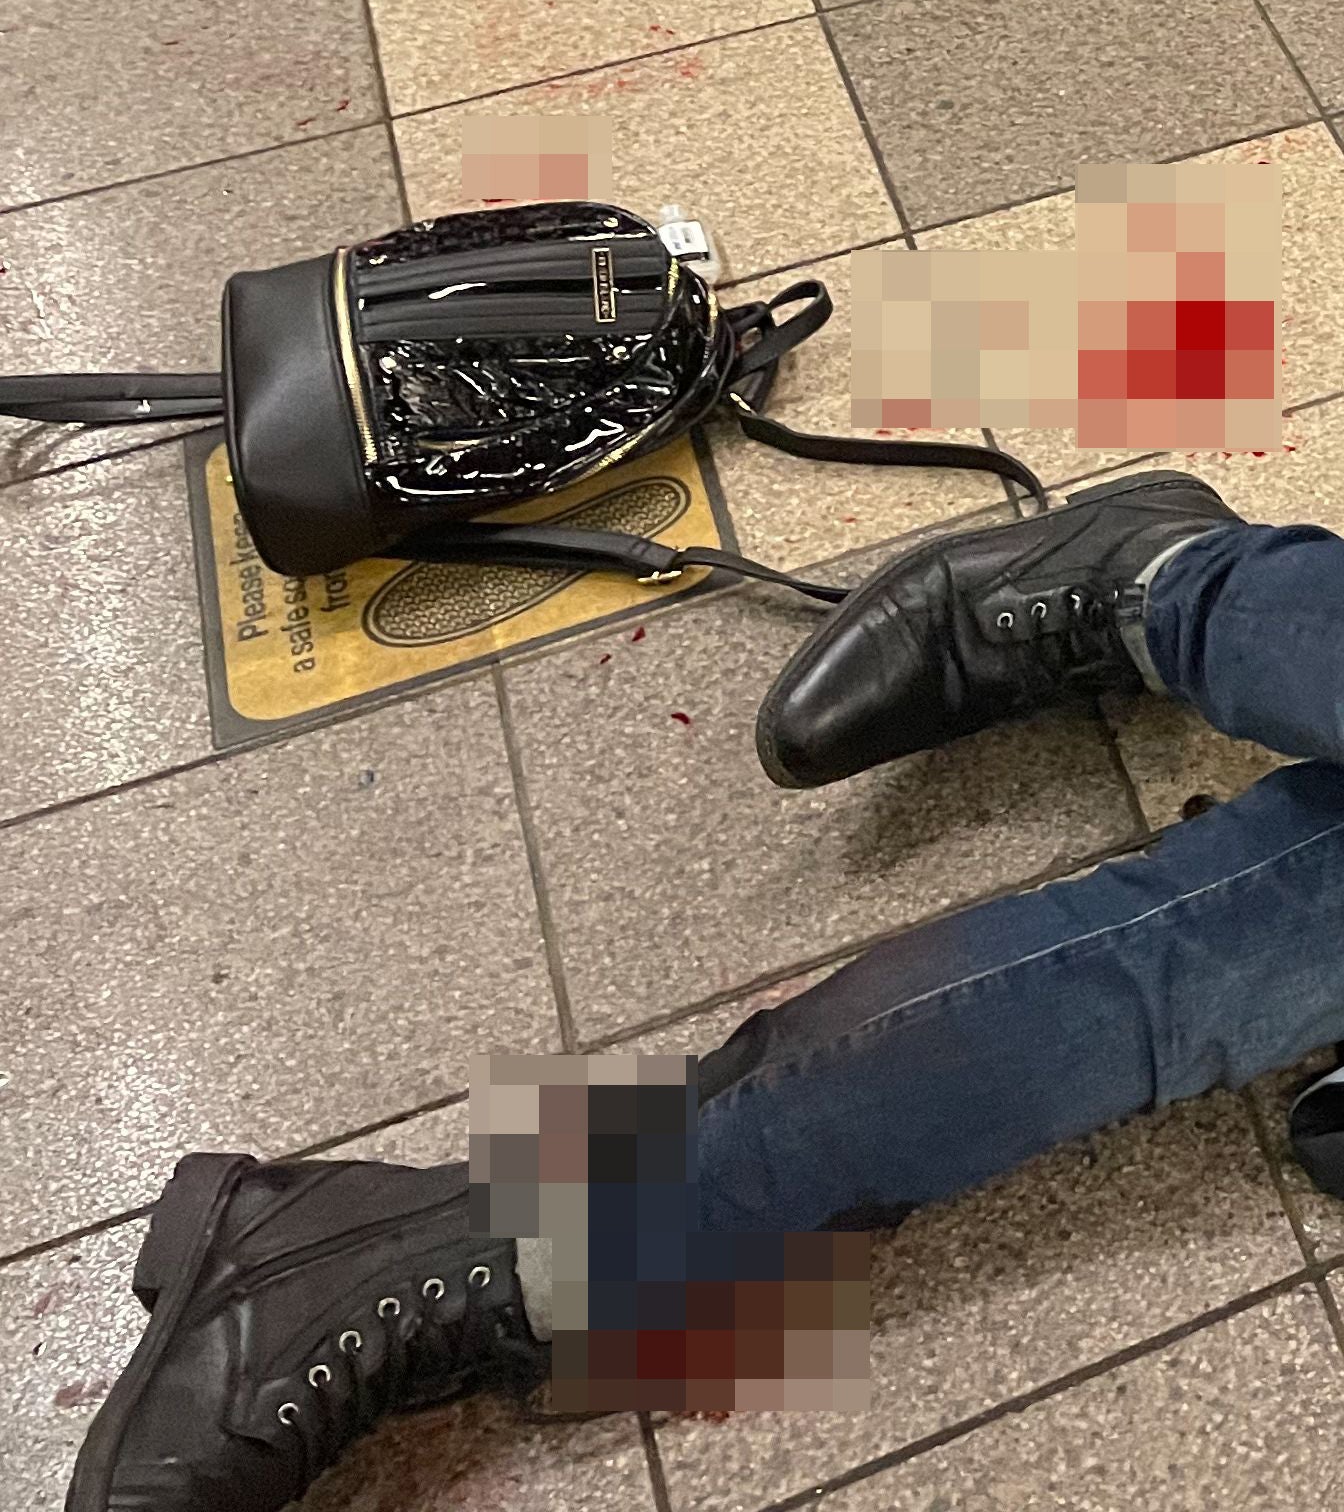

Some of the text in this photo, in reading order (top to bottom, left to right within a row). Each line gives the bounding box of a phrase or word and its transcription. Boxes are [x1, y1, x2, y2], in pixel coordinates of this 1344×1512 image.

[236, 564, 269, 641] Please
[280, 605, 314, 656] safe
[294, 657, 316, 672] a
